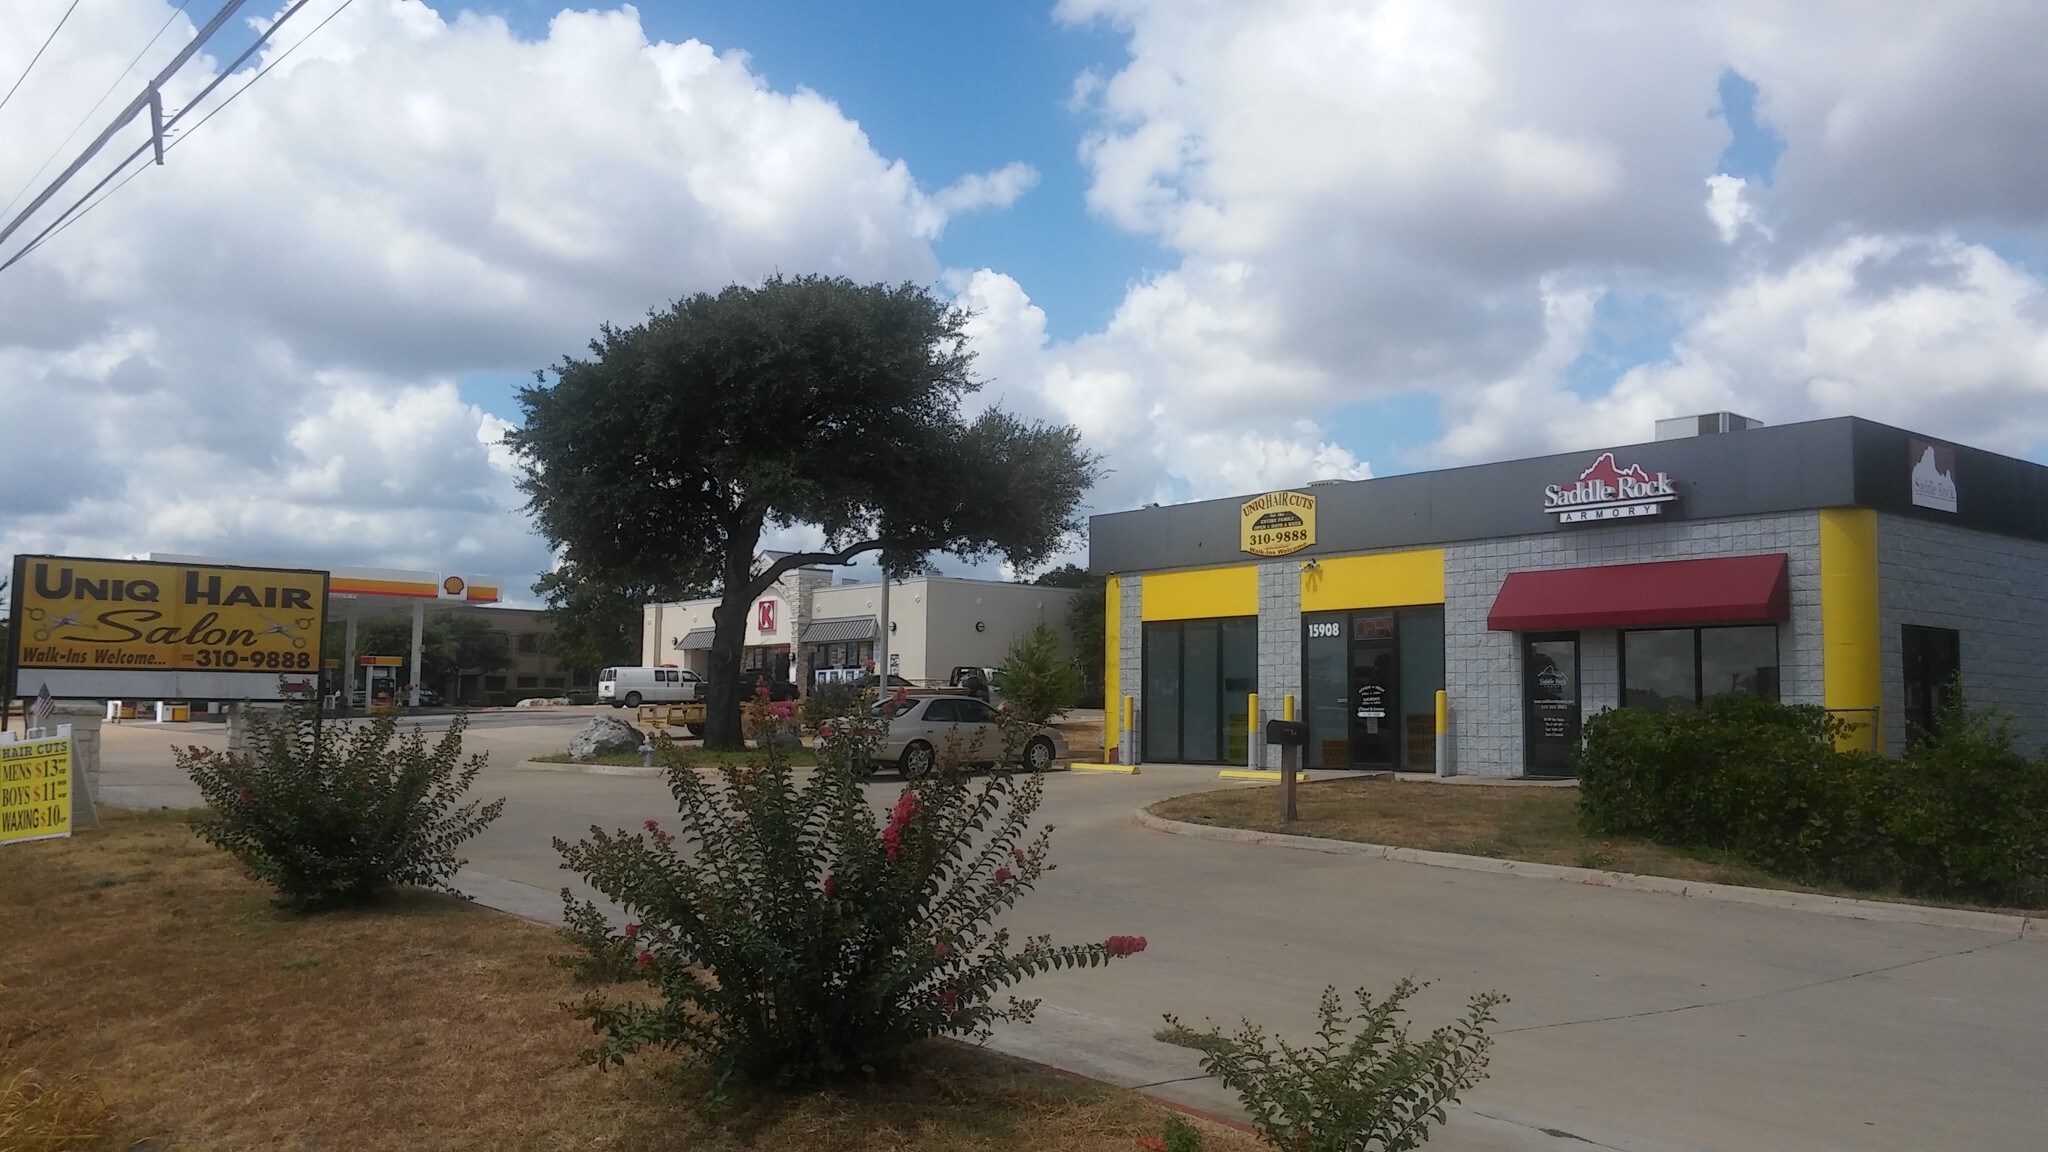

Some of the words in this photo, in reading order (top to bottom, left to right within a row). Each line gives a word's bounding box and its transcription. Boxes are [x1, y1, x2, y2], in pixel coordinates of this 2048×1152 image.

[1544, 479, 1616, 507] Saddle
[1617, 472, 1676, 500] Rock
[1243, 498, 1265, 517] UNIQ
[1265, 492, 1288, 509] HAIR
[1289, 495, 1313, 510] CUTS
[1566, 506, 1650, 521] ARMORY
[1250, 529, 1307, 546] 310-9888
[35, 563, 160, 602] UNIQ
[184, 570, 315, 610] HAIR
[61, 608, 259, 647] Salon
[1308, 622, 1340, 638] 15908
[1357, 617, 1393, 638] OPEN
[23, 647, 87, 664] Walk-Ins
[196, 649, 311, 669] 310-9888
[2, 746, 32, 759] HAIR
[37, 741, 67, 755] CUTS
[3, 763, 31, 782] MENS
[2, 785, 30, 807] BOYS
[2, 808, 39, 832] WAXING
